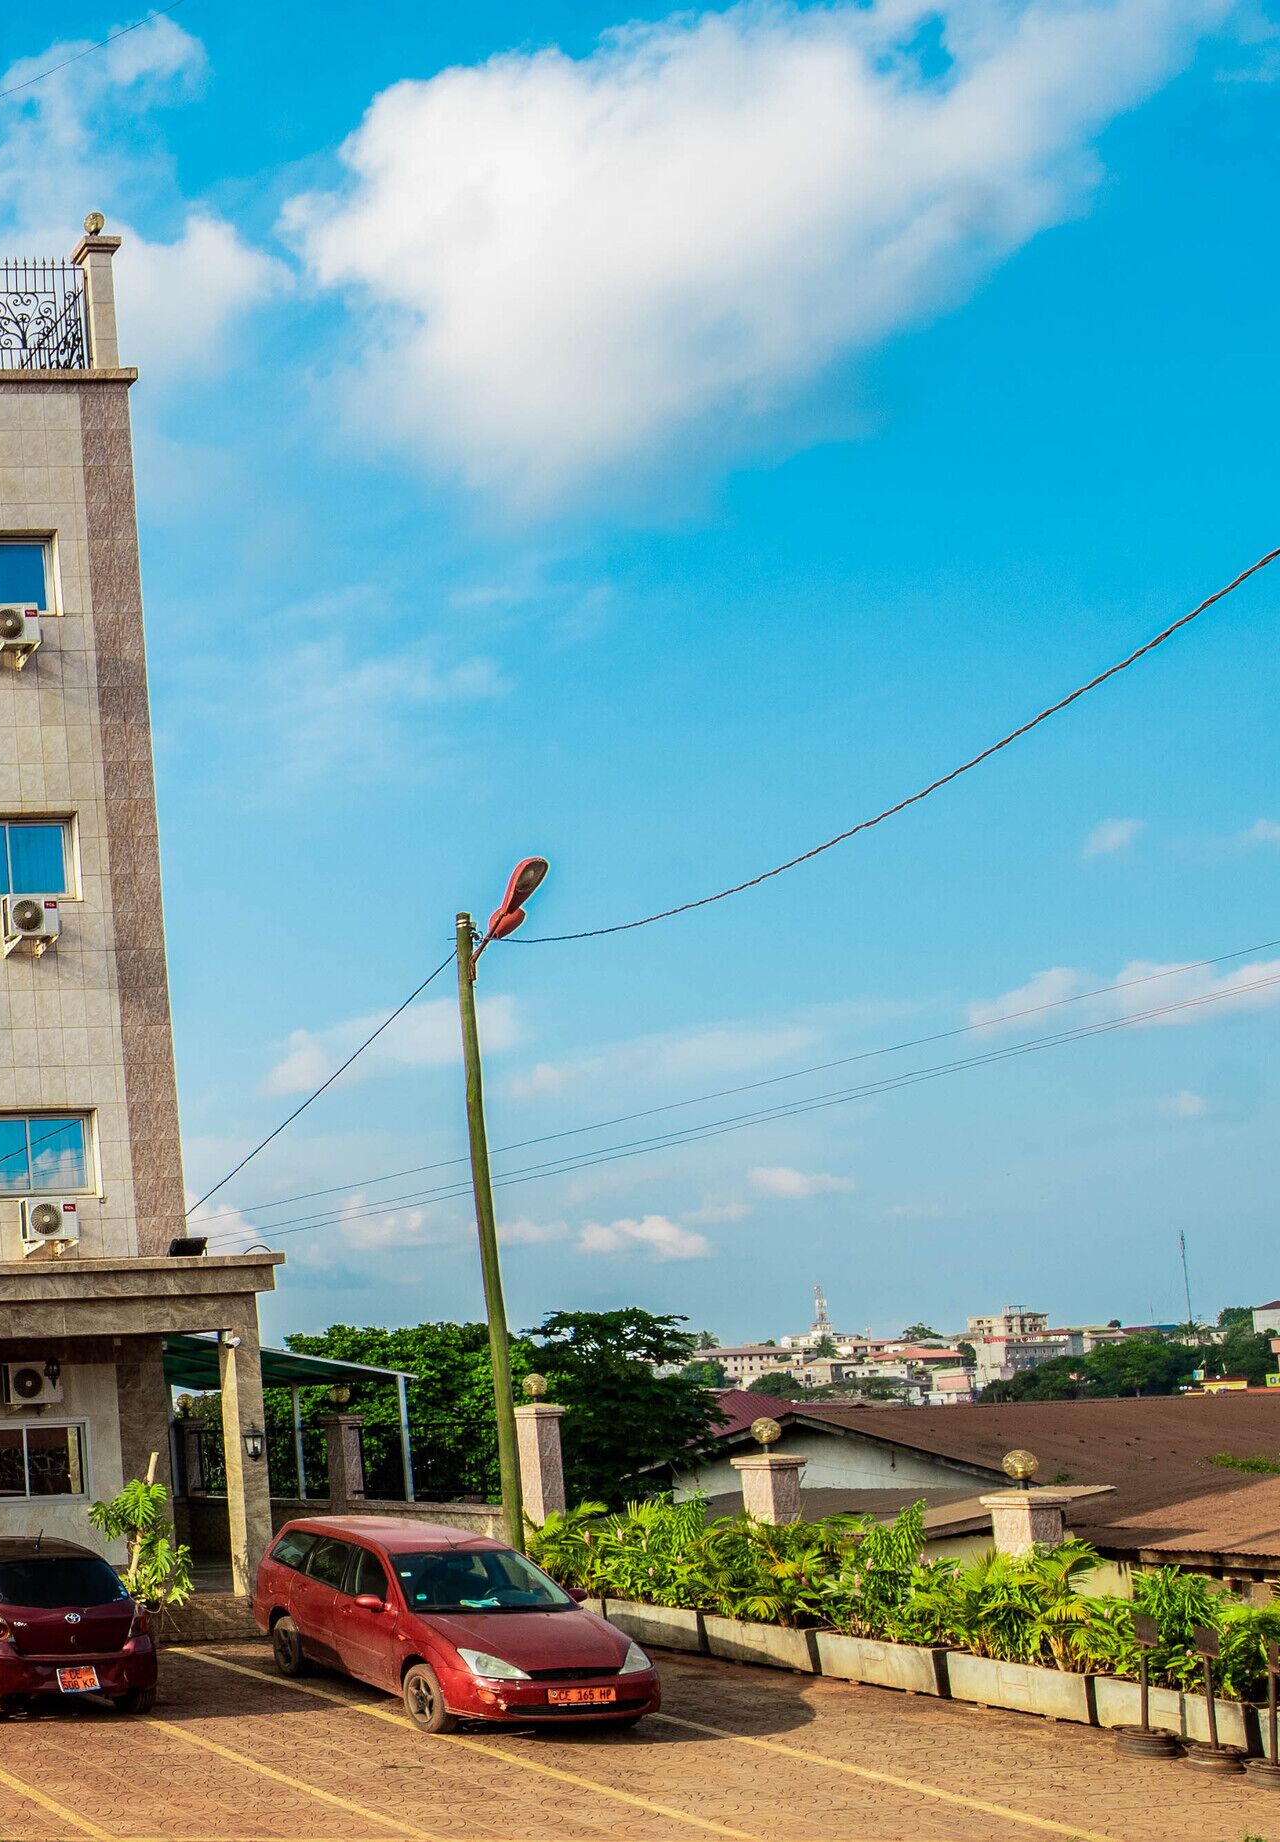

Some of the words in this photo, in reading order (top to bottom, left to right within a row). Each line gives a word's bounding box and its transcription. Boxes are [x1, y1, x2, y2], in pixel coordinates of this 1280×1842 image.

[82, 1677, 97, 1689] KR
[558, 1690, 572, 1701] CE
[577, 1689, 595, 1701] 165
[600, 1688, 612, 1700] HP
